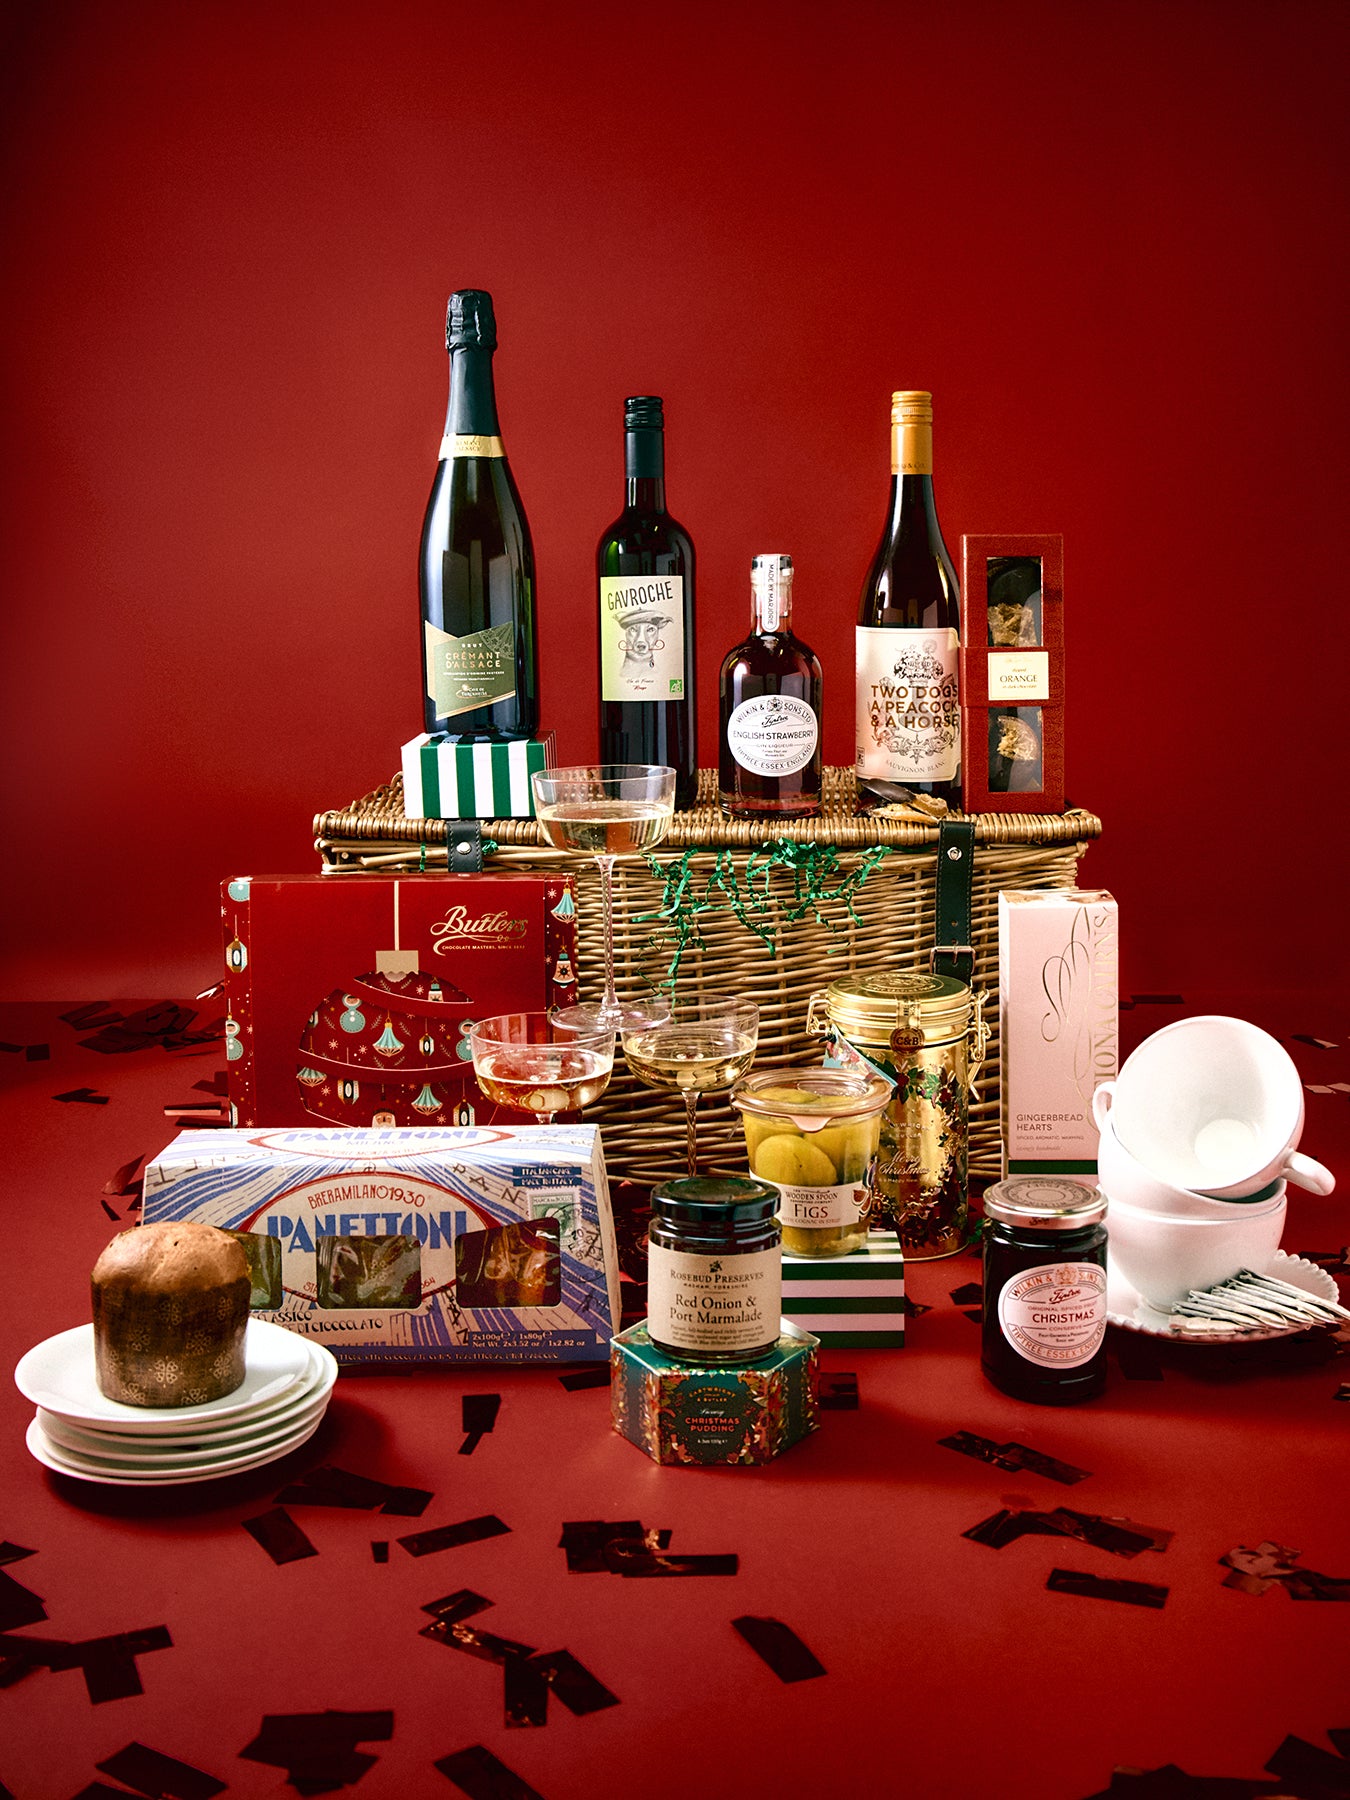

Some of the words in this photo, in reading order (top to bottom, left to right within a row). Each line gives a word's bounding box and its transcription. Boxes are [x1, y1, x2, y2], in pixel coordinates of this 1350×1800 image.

[608, 581, 673, 610] GAVROCHE
[768, 584, 774, 592] BY
[445, 651, 500, 660] CRÉMANT
[445, 660, 501, 668] D'ALSACE
[871, 685, 909, 698] TWO
[916, 684, 958, 699] DOGS
[736, 704, 758, 723] WILKIN
[784, 702, 802, 714] SONS
[802, 710, 812, 723] LTD
[871, 700, 880, 713] A
[885, 700, 958, 714] PEACOCK
[871, 714, 879, 727] &
[886, 715, 897, 728] A
[904, 714, 960, 728] HORSE
[733, 731, 765, 740] ENGLISH
[766, 730, 814, 740] STRAWBERRY
[736, 746, 758, 766] TIPTREE
[761, 762, 784, 770] ESSEX
[786, 744, 812, 767] ENGLAND
[885, 760, 925, 773] SAUVIGNON
[927, 760, 945, 772] BLANC
[430, 905, 528, 942] Butlers
[1094, 912, 1117, 1009] CAIRNS
[896, 1036, 919, 1046] C&B
[1016, 1113, 1084, 1122] GINGERBREAD
[1016, 1123, 1053, 1131] HEARTS
[786, 1192, 815, 1200] WOODEN
[794, 1204, 829, 1219] FIGS
[670, 1269, 712, 1283] ROSEBUD
[714, 1271, 764, 1284] PRESERVES
[1011, 1275, 1043, 1298] WILKIN
[1044, 1274, 1053, 1282] &
[676, 1293, 697, 1308] Red
[701, 1296, 742, 1309] Onion
[746, 1295, 756, 1308] &
[670, 1306, 693, 1322] Port
[697, 1308, 763, 1324] Marmalade
[1032, 1309, 1094, 1324] CHRISTMAS
[1011, 1327, 1043, 1354] TIPTREE
[1046, 1350, 1078, 1359] ESSEX
[685, 1417, 740, 1425] CHRISTMAS
